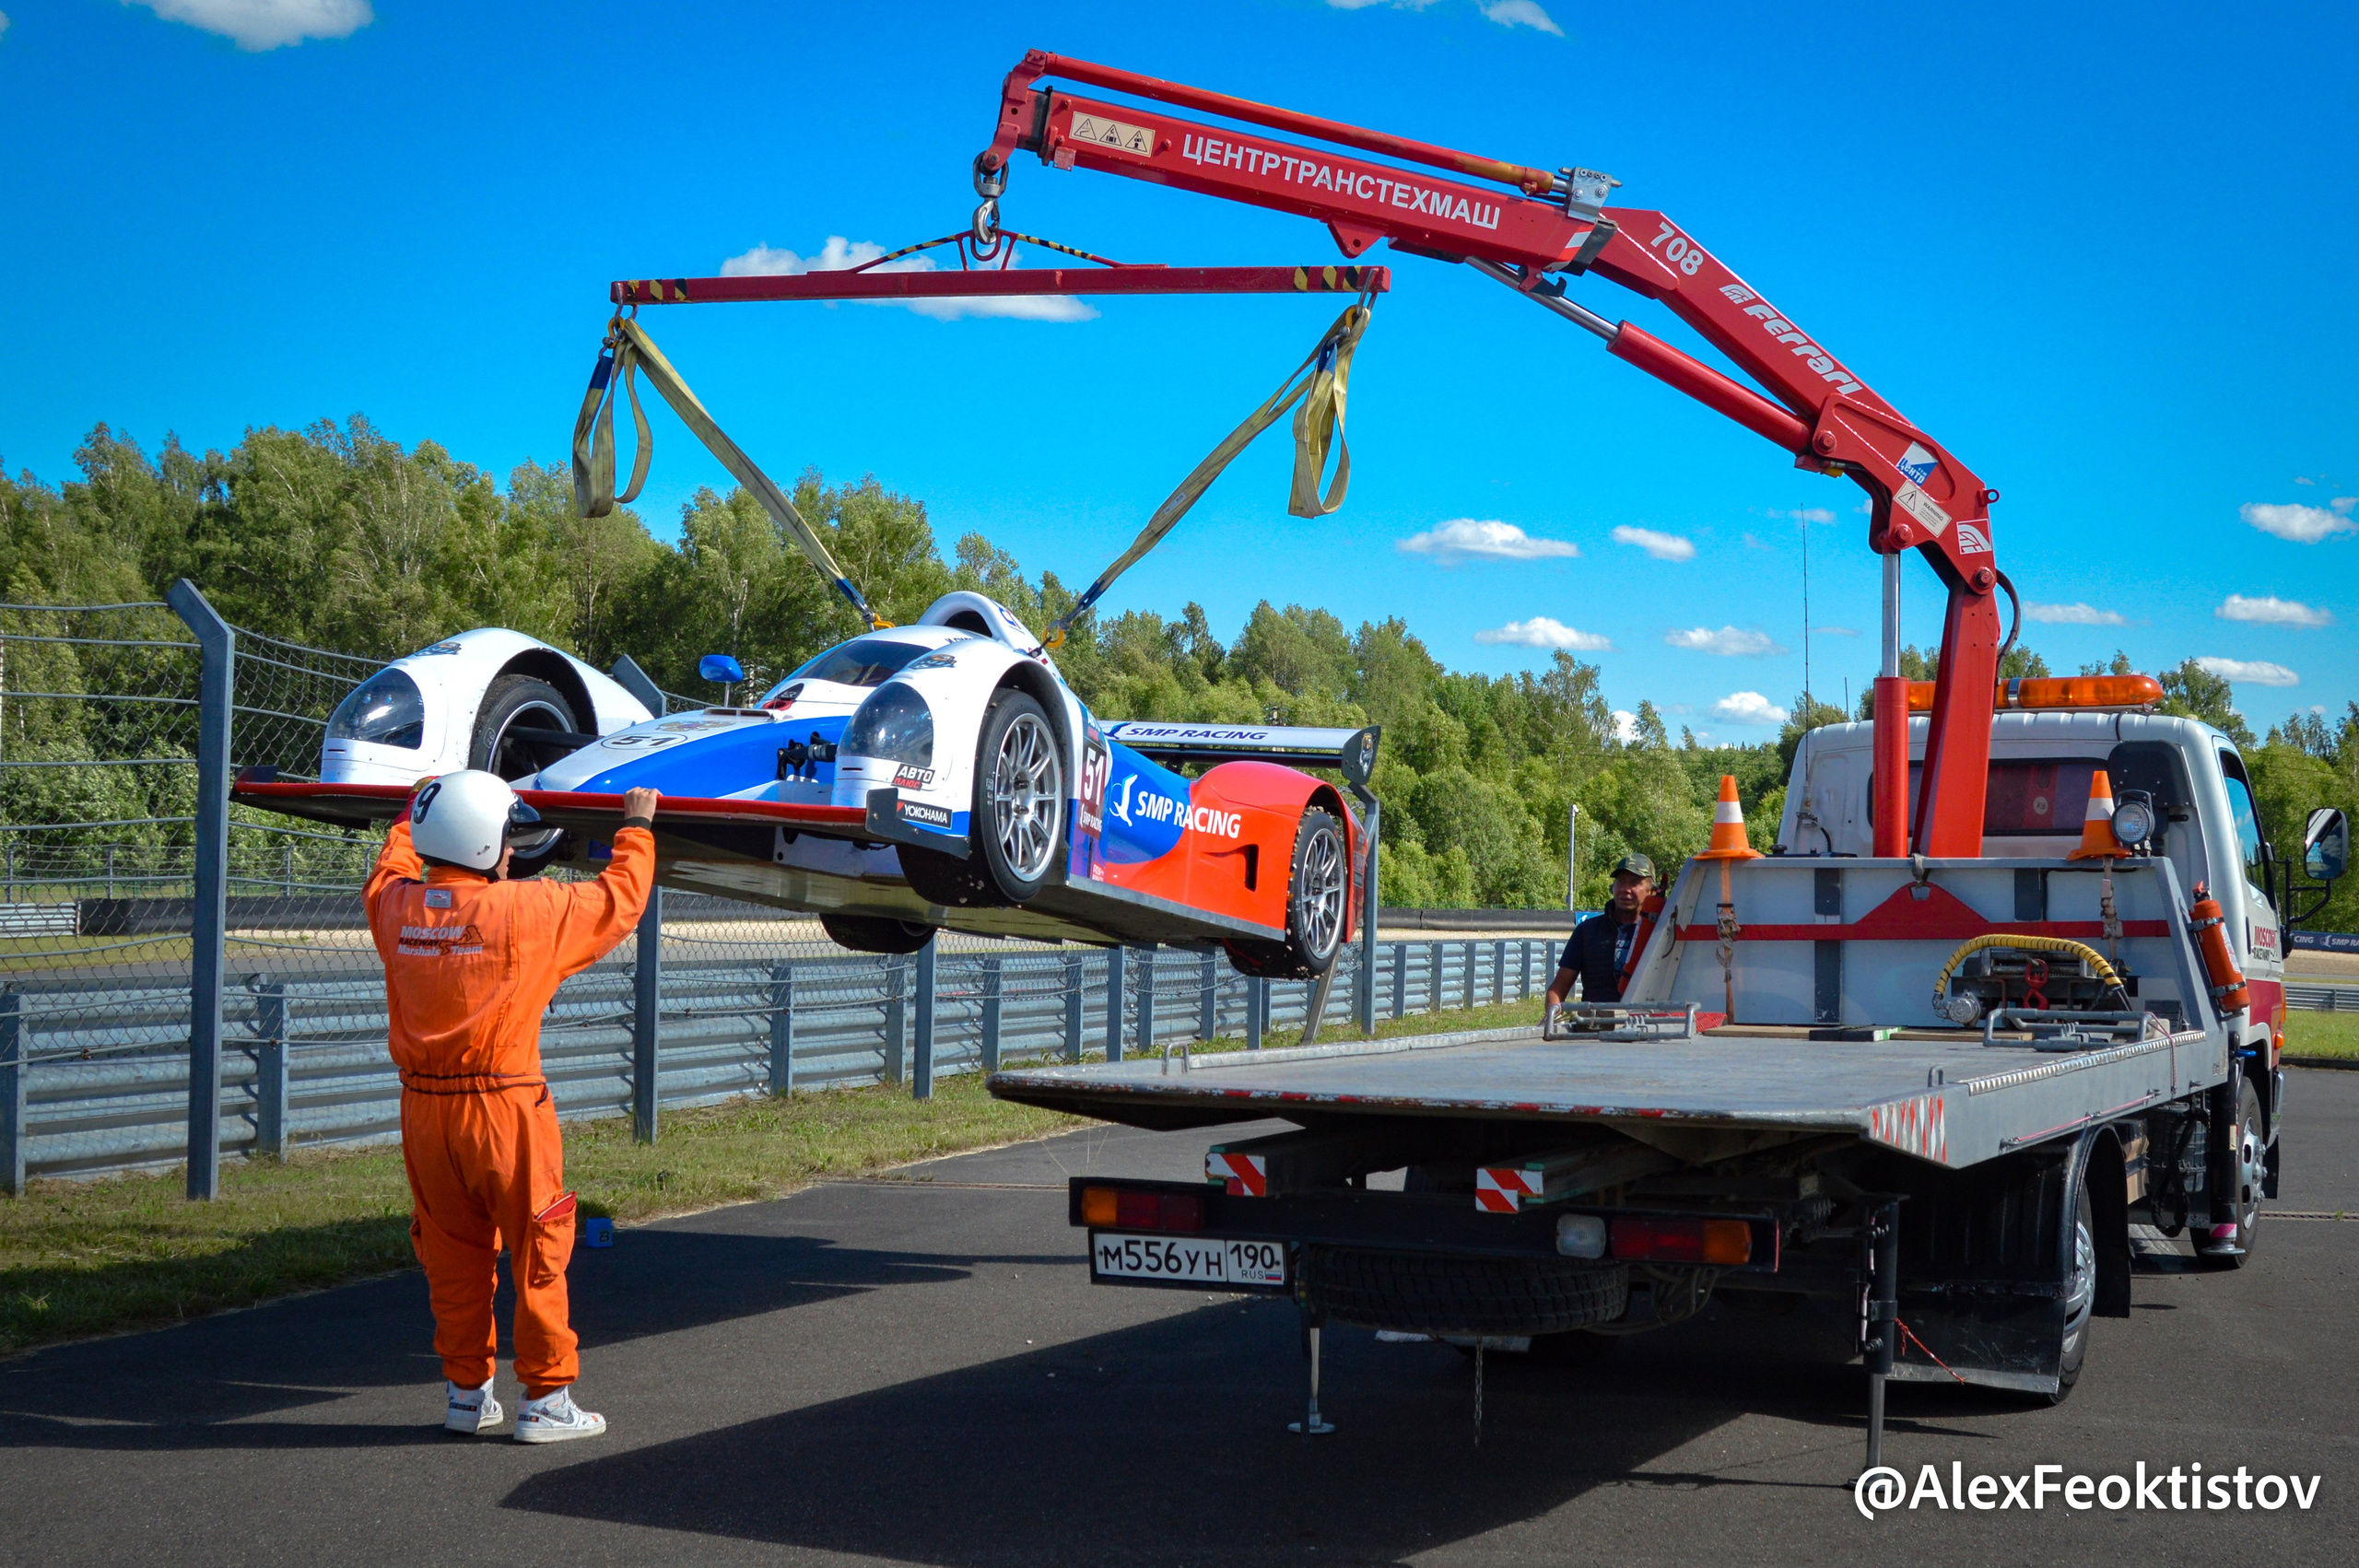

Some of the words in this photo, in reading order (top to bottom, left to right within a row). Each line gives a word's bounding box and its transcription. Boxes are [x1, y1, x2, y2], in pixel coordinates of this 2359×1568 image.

[1182, 134, 1501, 230] ЦЕНТРТРАНСТЕХМАШ
[1649, 222, 1705, 275] 708
[1898, 458, 1926, 485] Центр
[1922, 501, 1944, 521] WARNING
[612, 735, 678, 746] 51
[1126, 728, 1179, 736] SMP
[1179, 730, 1269, 740] RACING
[894, 778, 921, 789] ПЛЮС
[898, 766, 933, 783] АВТО
[1084, 747, 1105, 806] 51
[413, 782, 441, 825] 9
[904, 804, 947, 824] YOKOHAMA
[1135, 790, 1173, 822] SMP
[1173, 801, 1241, 839] RACING
[398, 937, 440, 947] RACEWAY
[401, 925, 466, 940] MOSCOW
[2254, 926, 2276, 949] MOSCOW
[2294, 935, 2314, 943] CING
[397, 944, 440, 956] Marshals
[451, 945, 484, 955] Team
[1229, 1244, 1275, 1269] 190
[1241, 1270, 1264, 1280] RUS
